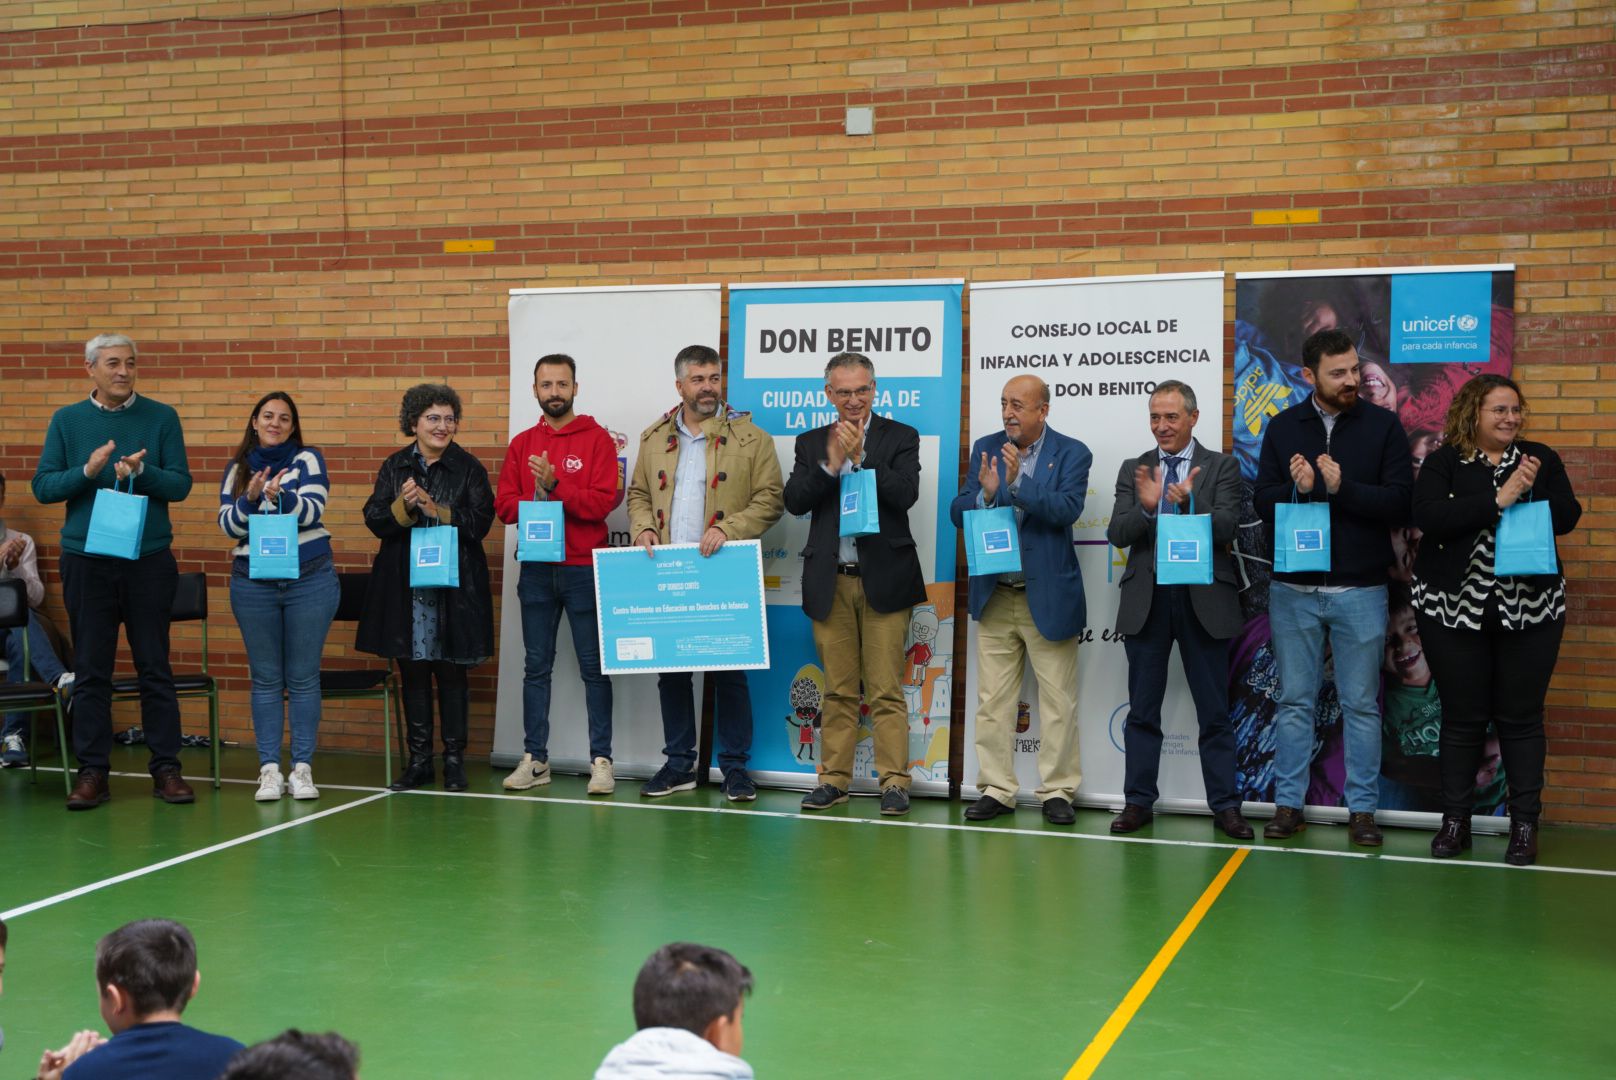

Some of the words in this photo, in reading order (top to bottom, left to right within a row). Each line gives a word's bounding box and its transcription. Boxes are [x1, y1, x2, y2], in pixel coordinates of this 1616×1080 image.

[1011, 322, 1092, 339] CONSEJO
[1097, 320, 1152, 336] LOCAL
[1157, 319, 1178, 333] DE
[1402, 314, 1456, 333] unicef
[759, 328, 818, 354] DON
[827, 326, 932, 353] BENITO
[1402, 342, 1421, 352] para
[1422, 340, 1443, 350] cada
[1444, 340, 1478, 350] infancia
[980, 353, 1059, 370] INFANCIA
[1063, 353, 1073, 367] Y
[1078, 348, 1211, 367] ADOLESCENCIA
[1055, 383, 1093, 397] DON
[1099, 381, 1158, 396] BENITO
[762, 390, 828, 408] CIUDAD
[897, 390, 921, 407] DE
[785, 412, 807, 429] LA
